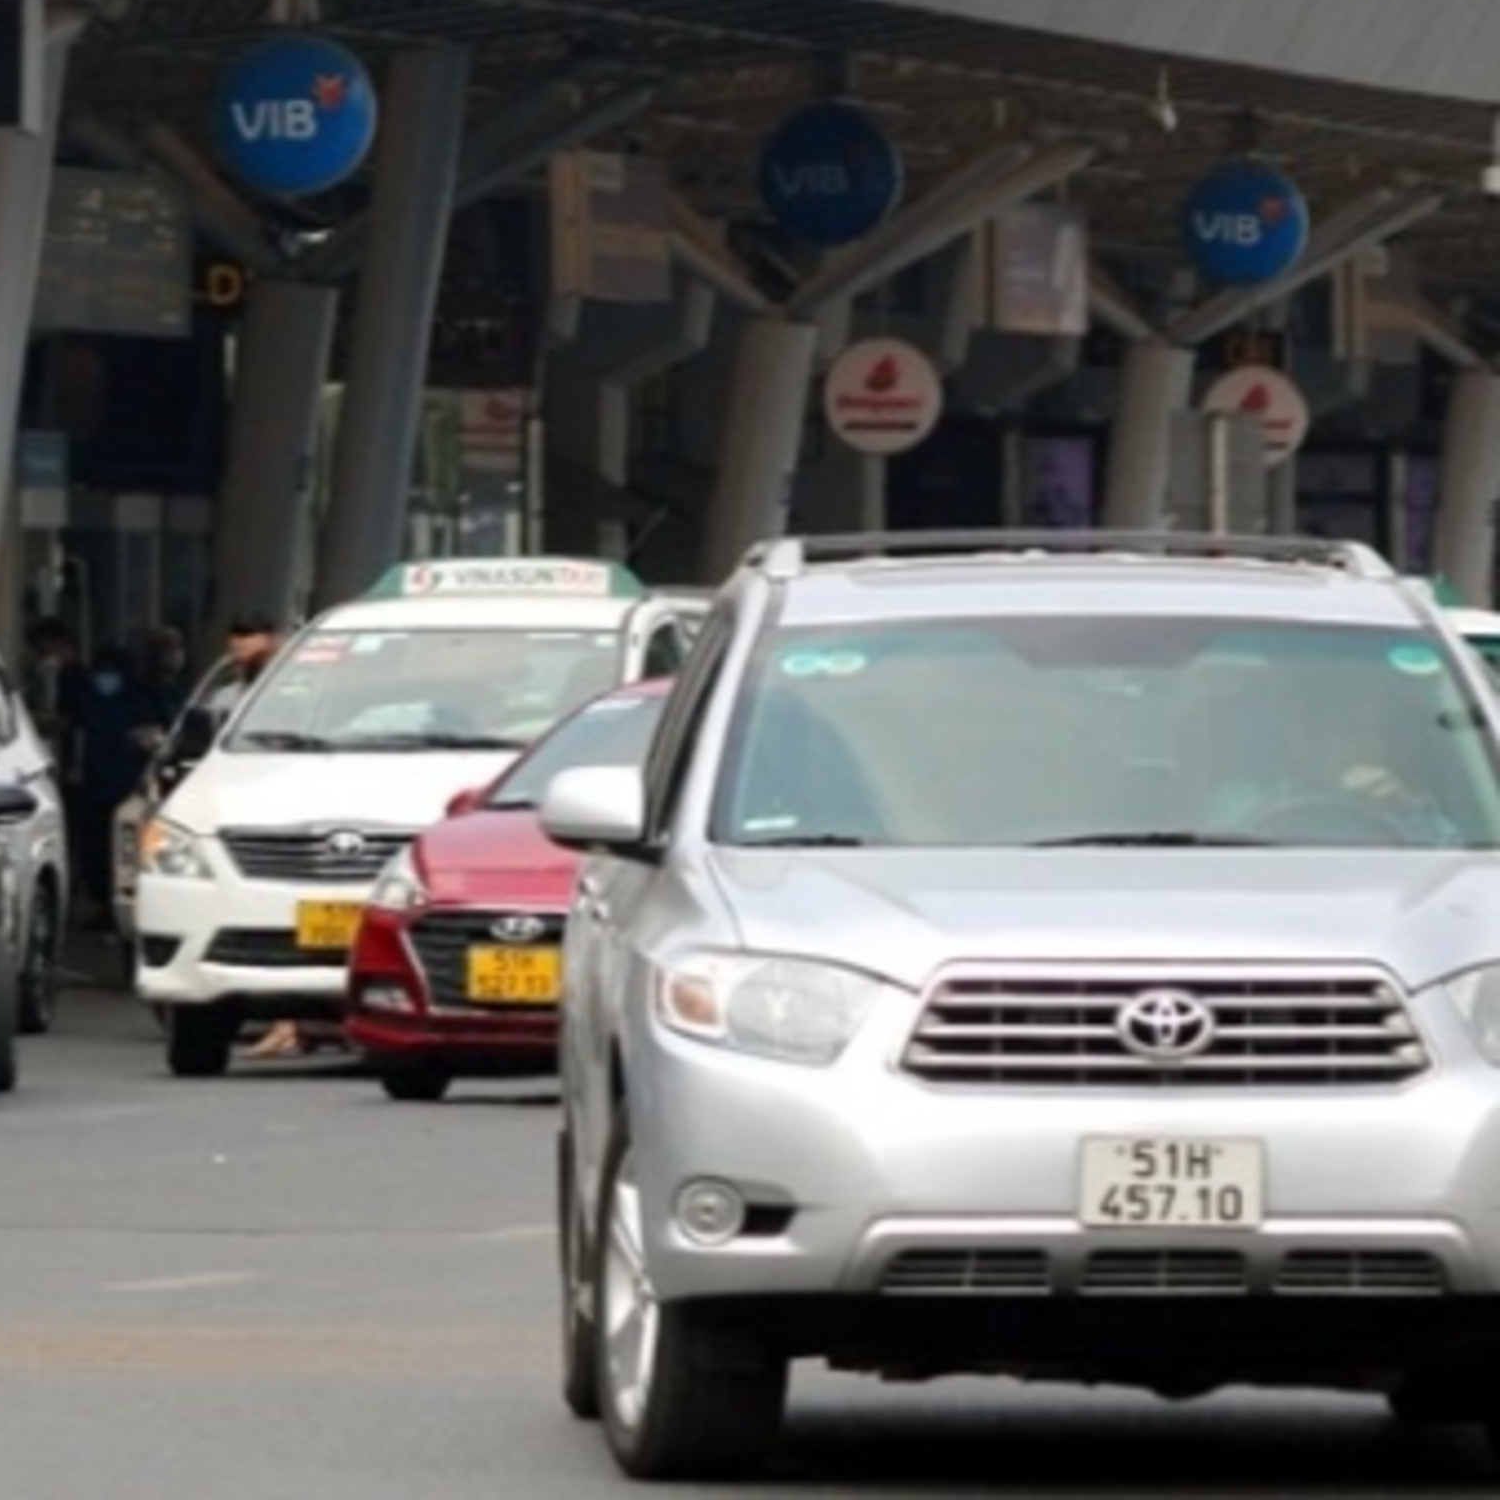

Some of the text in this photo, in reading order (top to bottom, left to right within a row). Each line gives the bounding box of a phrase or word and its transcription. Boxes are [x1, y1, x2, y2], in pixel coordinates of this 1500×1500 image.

[232, 99, 318, 141] VIB
[774, 162, 848, 198] VIB
[1194, 210, 1263, 246] VIB
[1131, 1141, 1211, 1178] 51H
[1099, 1184, 1243, 1221] 457.10
